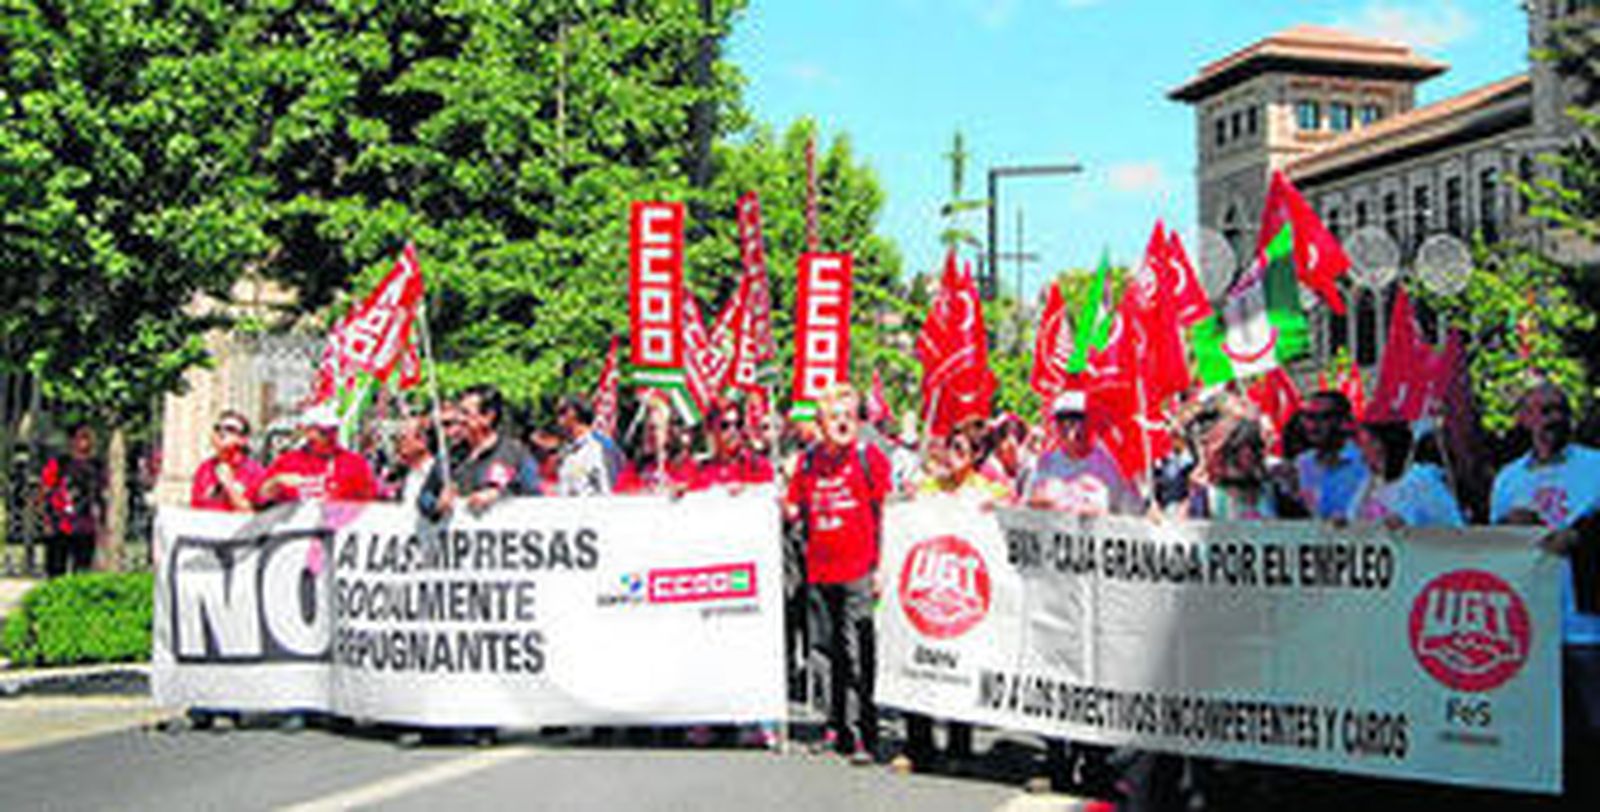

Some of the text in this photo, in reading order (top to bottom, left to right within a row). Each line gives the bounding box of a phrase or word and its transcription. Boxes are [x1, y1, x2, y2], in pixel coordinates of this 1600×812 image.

[640, 208, 673, 362] CCOO
[803, 257, 842, 398] CCOO
[338, 532, 358, 570] A
[908, 550, 980, 597] UGT
[1103, 538, 1204, 583] GRANADA
[1208, 543, 1257, 586] POR
[1264, 543, 1293, 586] EL
[1300, 544, 1394, 589] EMPLEO
[176, 538, 332, 656] NO
[1421, 588, 1511, 636] UGT
[1323, 705, 1337, 751] Y
